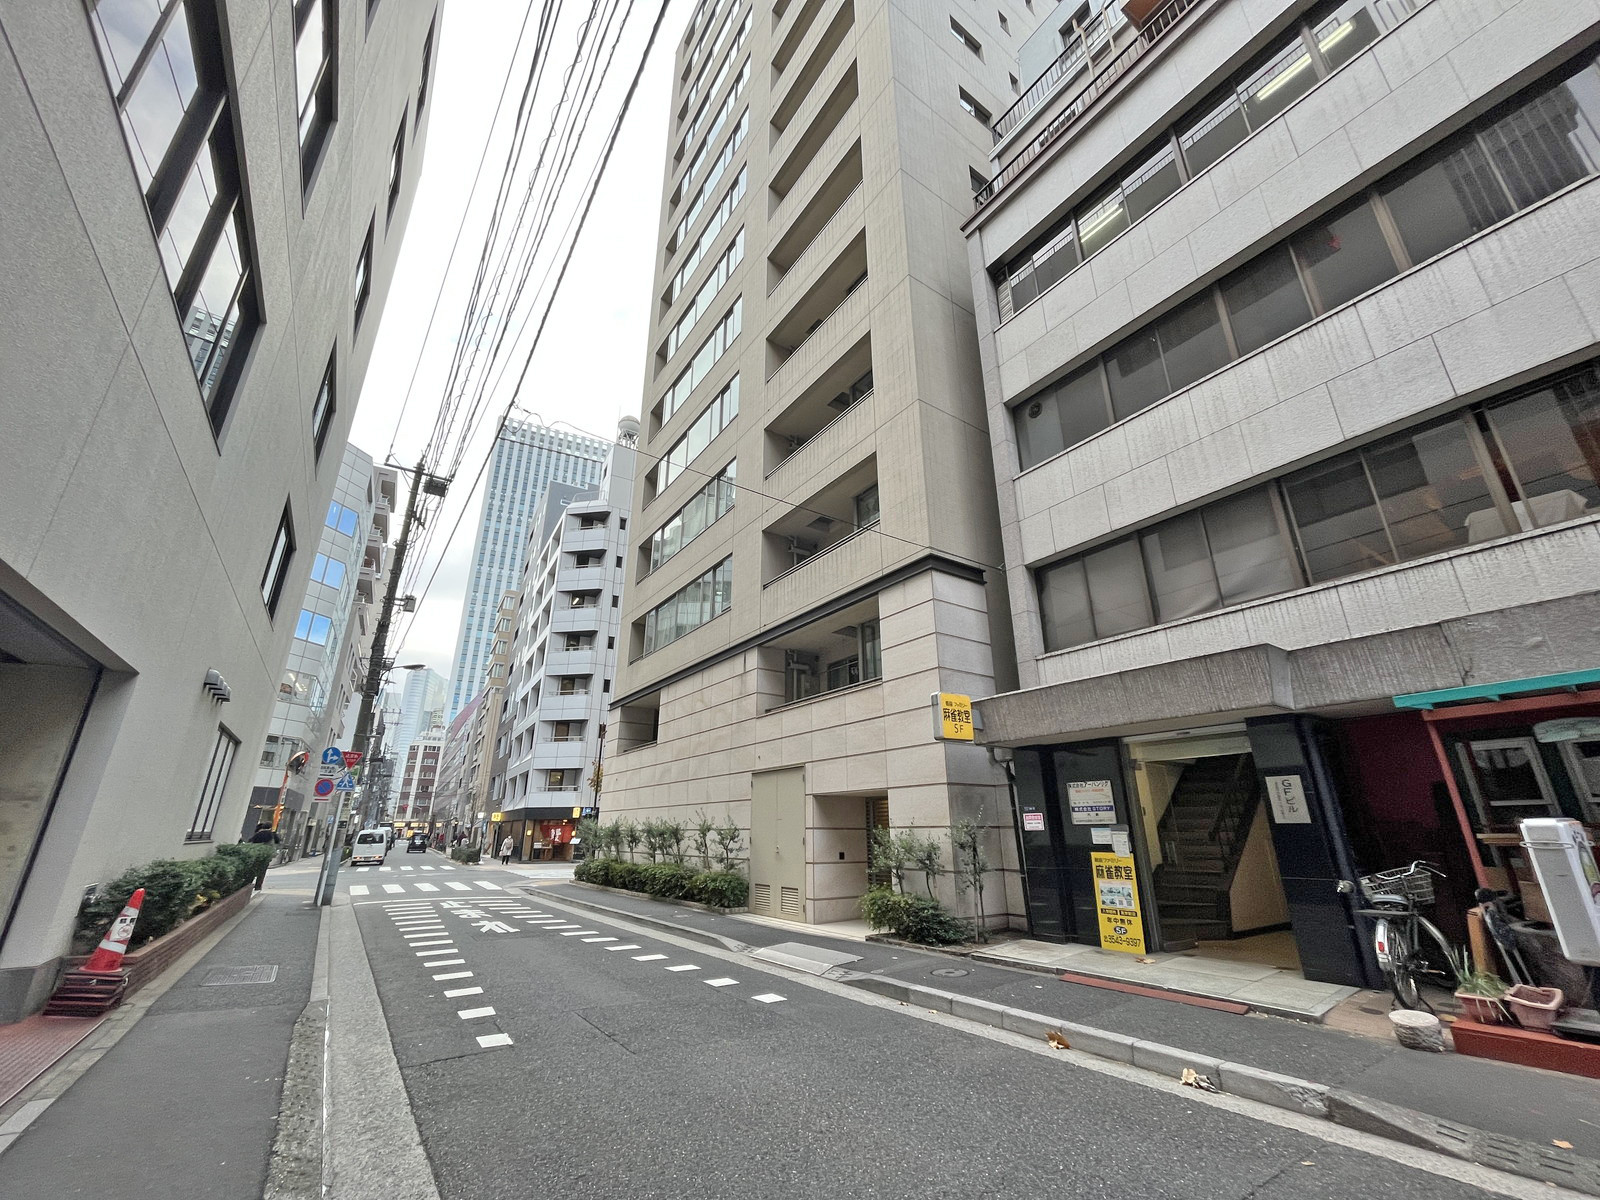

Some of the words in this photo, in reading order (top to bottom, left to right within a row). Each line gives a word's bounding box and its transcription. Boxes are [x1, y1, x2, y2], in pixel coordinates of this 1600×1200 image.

[942, 708, 971, 724] 麻雀教室
[1095, 864, 1134, 881] 麻雀教室
[440, 900, 521, 934] 止まれ
[1106, 917, 1133, 926] 年中無休
[1115, 926, 1127, 934] SF
